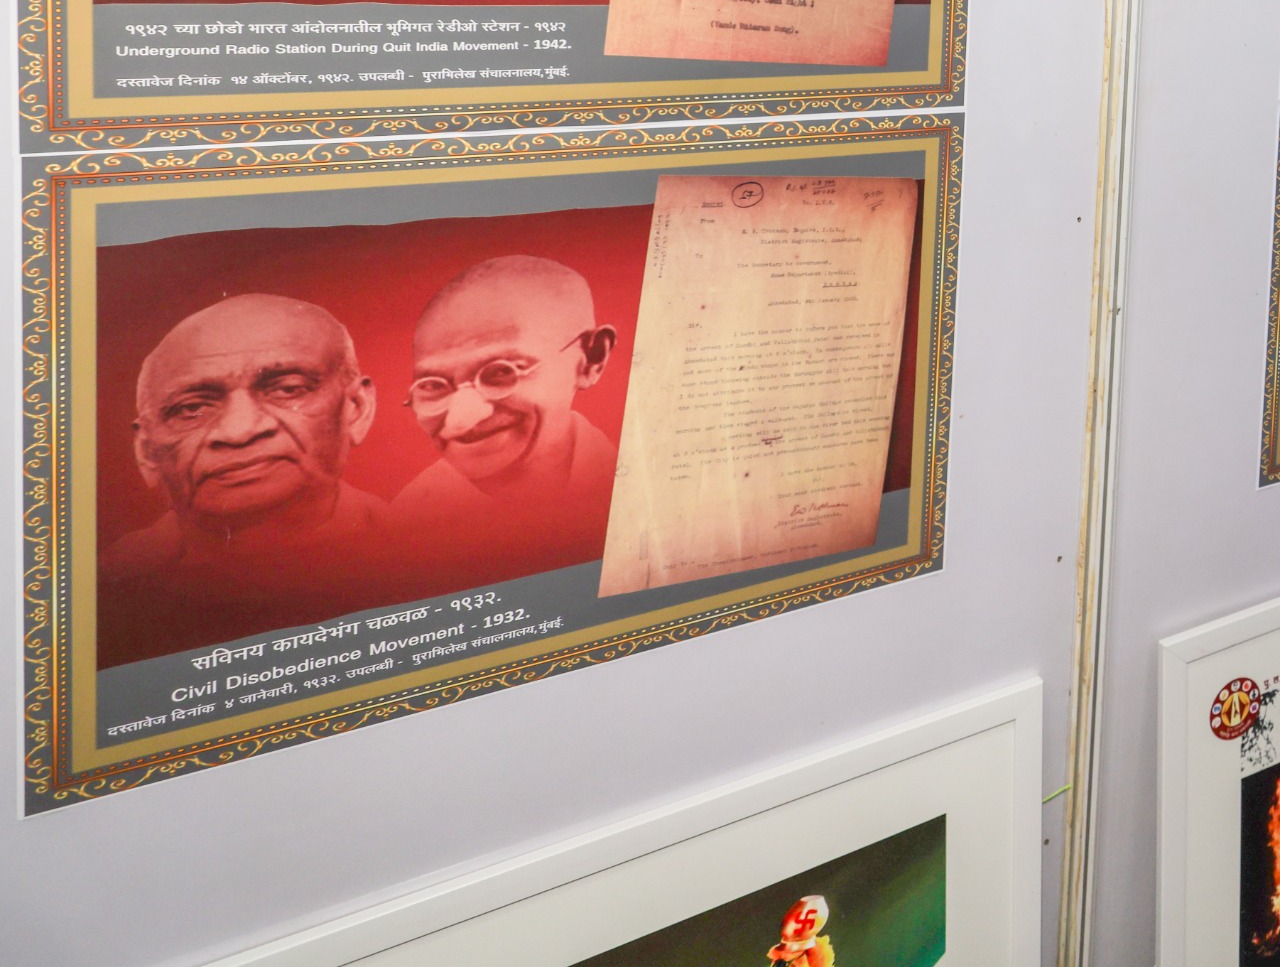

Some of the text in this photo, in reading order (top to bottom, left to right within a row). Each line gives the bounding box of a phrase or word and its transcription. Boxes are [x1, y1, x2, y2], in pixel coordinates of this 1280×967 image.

[116, 39, 572, 58] Underground Radio Station During Quit India Movement 1942.
[125, 19, 566, 37] १९४२ च्या छोडो भारत आंदोलनातील भूमिगत रेडीओ स्टेशन १९४२
[116, 75, 175, 88] दस्तावेज
[178, 74, 222, 86] दिनांक
[231, 76, 248, 84] १४
[317, 73, 354, 84] १९४२.
[358, 69, 405, 81] उपलब्धी
[171, 608, 530, 702] Civil Disobedience Movement 1932.
[191, 592, 501, 670] सविनय कायदेभंग चळवळ १९३२.
[107, 715, 167, 736] दस्तावेज
[170, 703, 216, 721] दिनांक
[225, 698, 234, 708] ४
[239, 682, 297, 704] जानेवारी,
[303, 675, 340, 689] १९३२.
[345, 658, 394, 678] उपलब्धी
